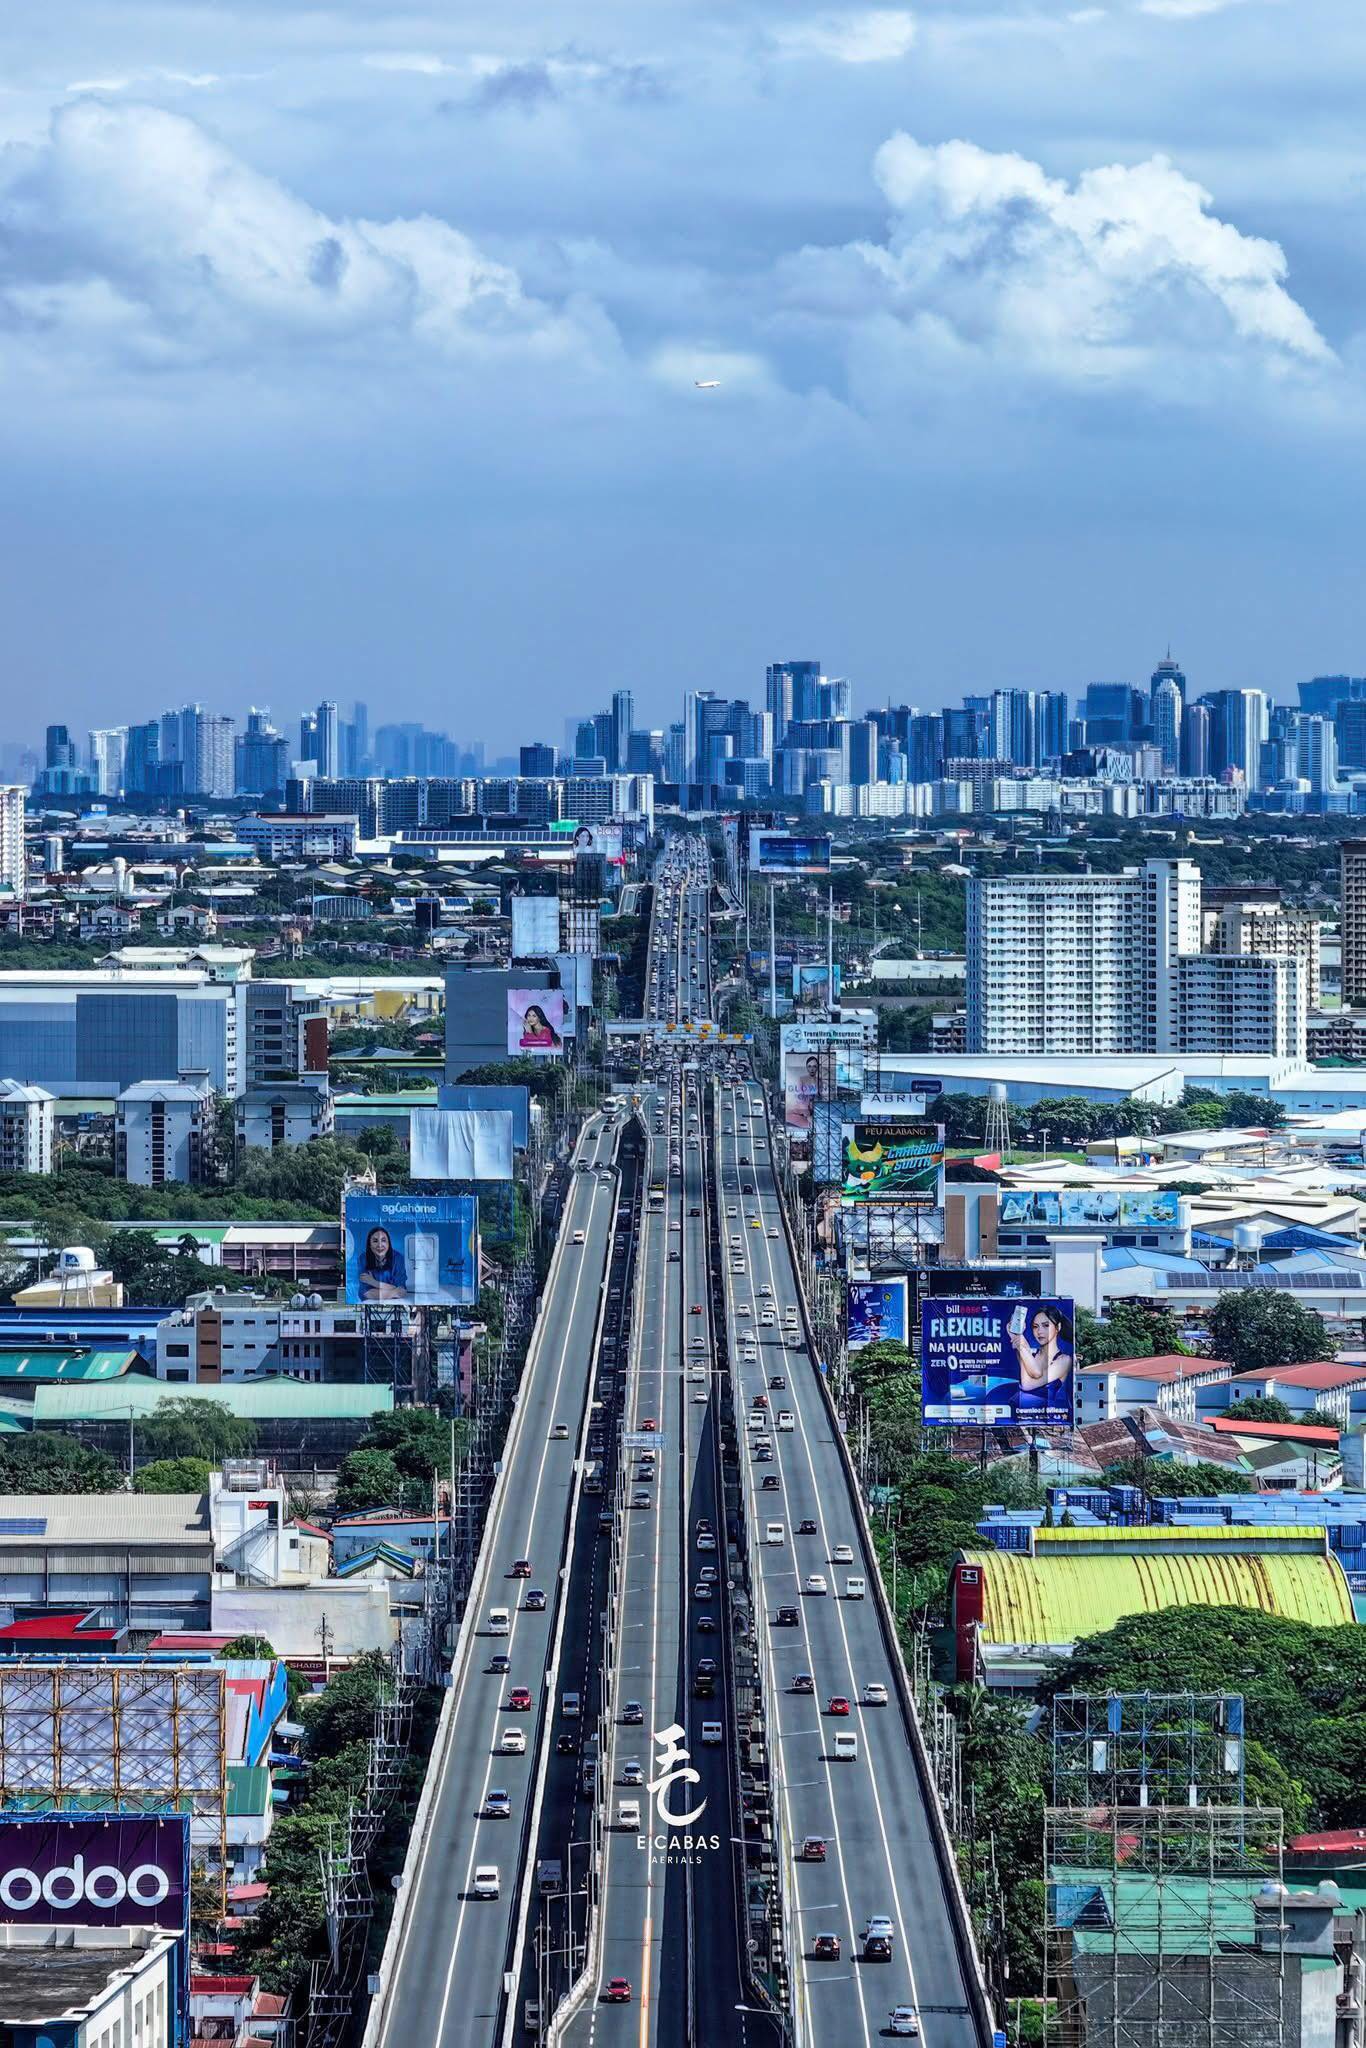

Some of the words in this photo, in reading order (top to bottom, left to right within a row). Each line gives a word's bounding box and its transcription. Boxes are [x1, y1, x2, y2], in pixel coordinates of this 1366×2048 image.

[931, 1317, 1001, 1338] FLEXIBLE
[929, 1343, 945, 1353] NA
[947, 1342, 1002, 1353] HULUGAN
[0, 1853, 169, 1911] odoo
